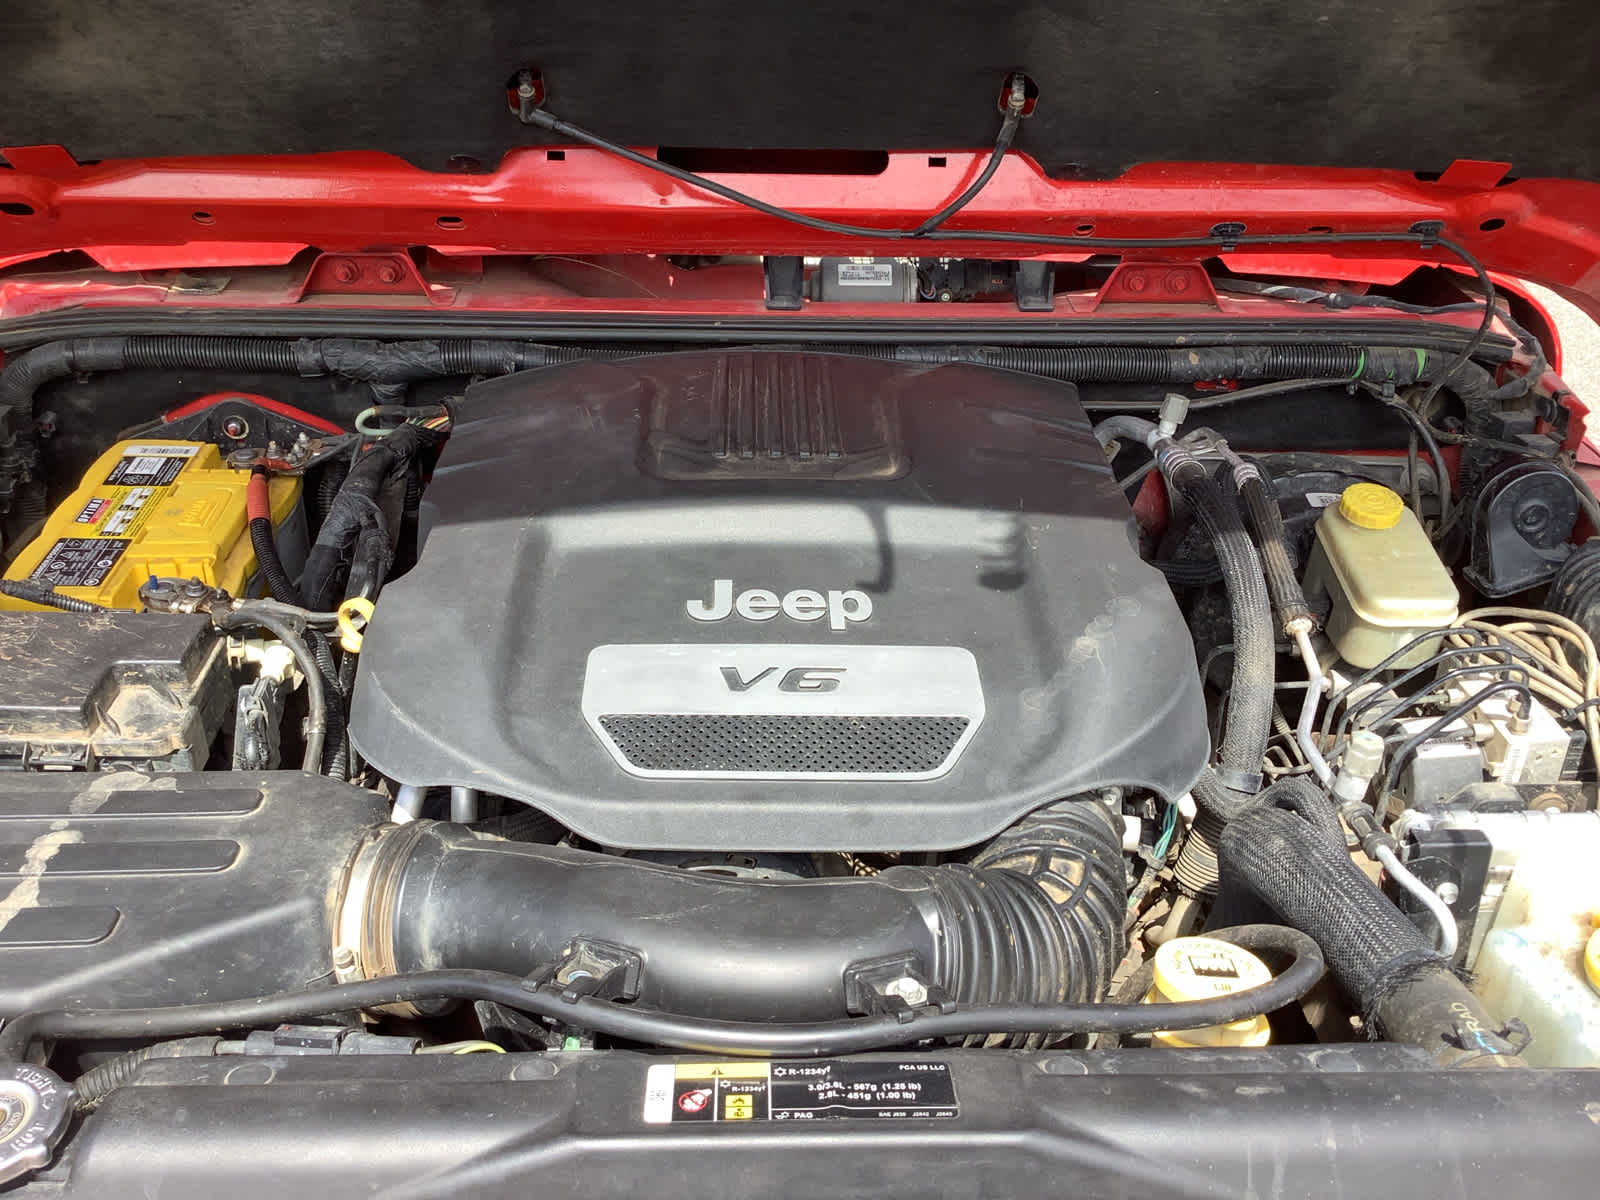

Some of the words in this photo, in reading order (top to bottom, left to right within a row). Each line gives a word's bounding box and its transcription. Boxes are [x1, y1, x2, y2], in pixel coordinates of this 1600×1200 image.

[77, 499, 105, 523] OPTIMA
[686, 578, 874, 630] Jeep
[719, 666, 848, 693] V6
[788, 1065, 831, 1076] R-1234yf
[902, 1092, 916, 1100] lb)
